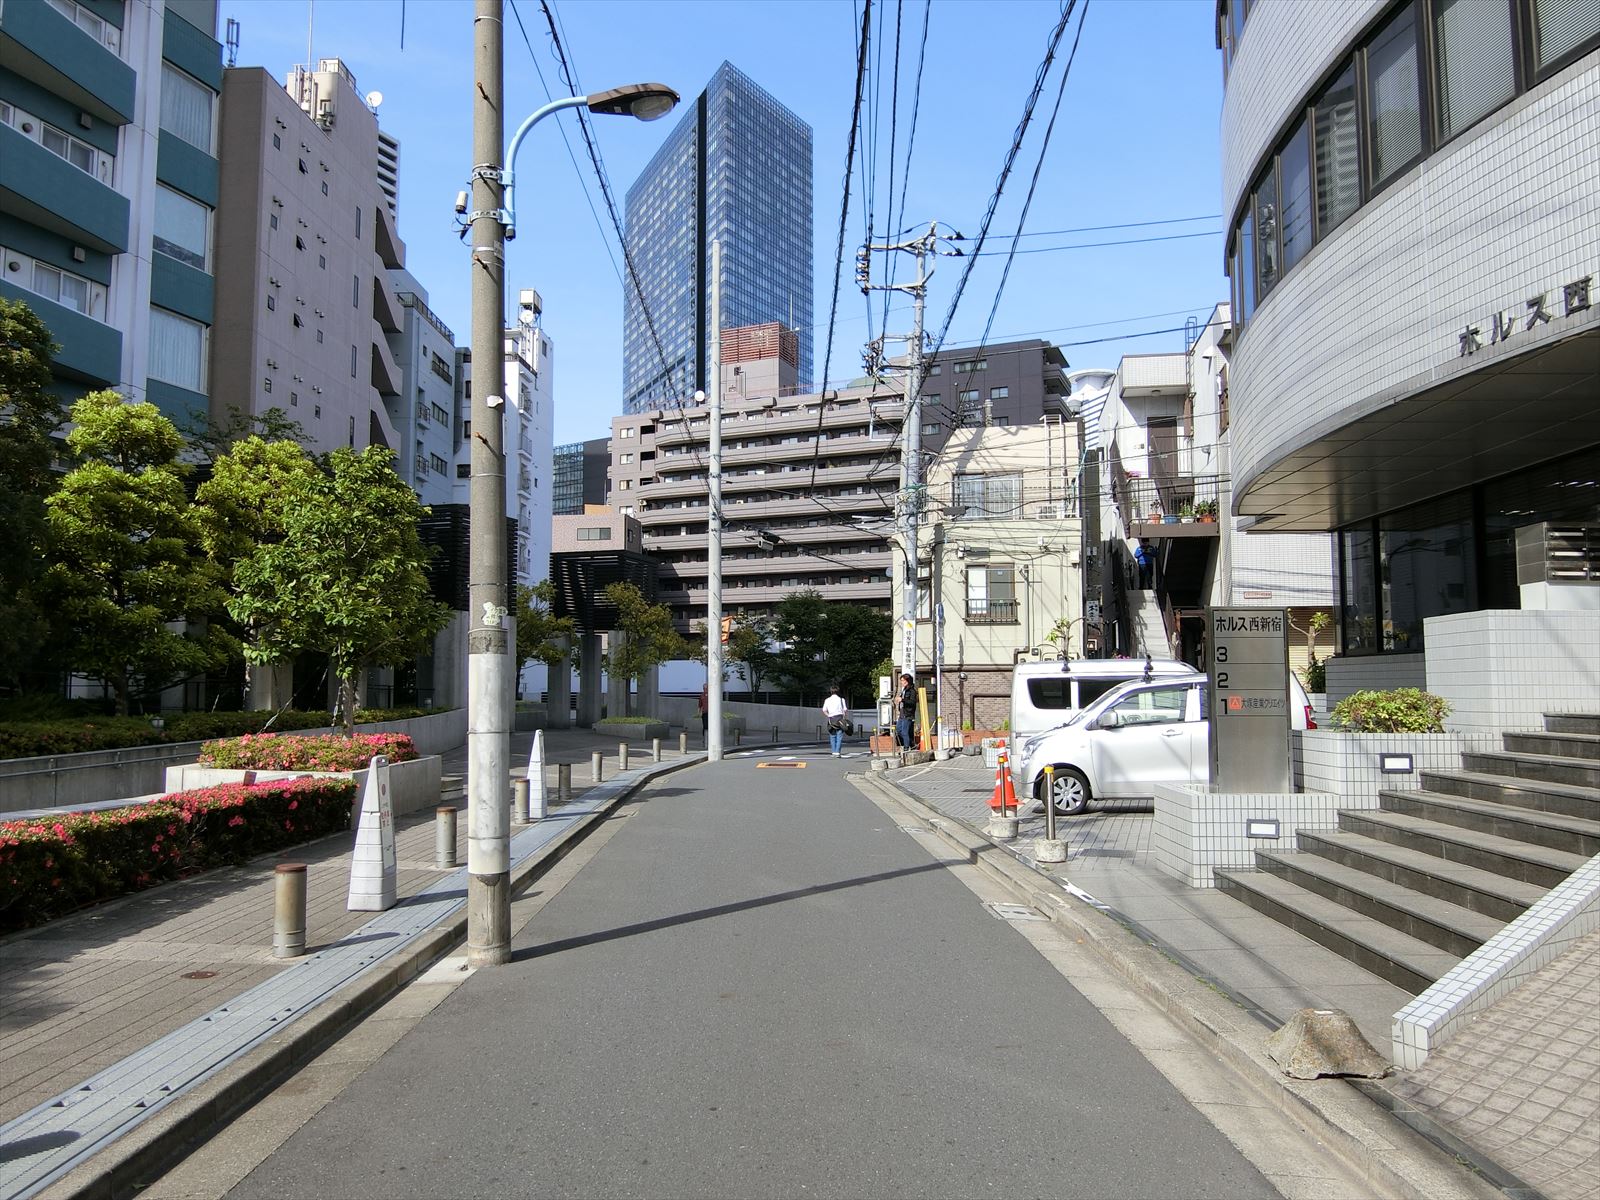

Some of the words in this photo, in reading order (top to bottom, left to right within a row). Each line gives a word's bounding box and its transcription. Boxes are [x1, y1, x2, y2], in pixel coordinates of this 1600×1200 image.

[1459, 275, 1593, 357] ホルス西
[1215, 616, 1282, 632] ホルス西新宿
[1216, 646, 1228, 662] 3
[1217, 672, 1229, 688] 2
[1220, 698, 1228, 715] 1
